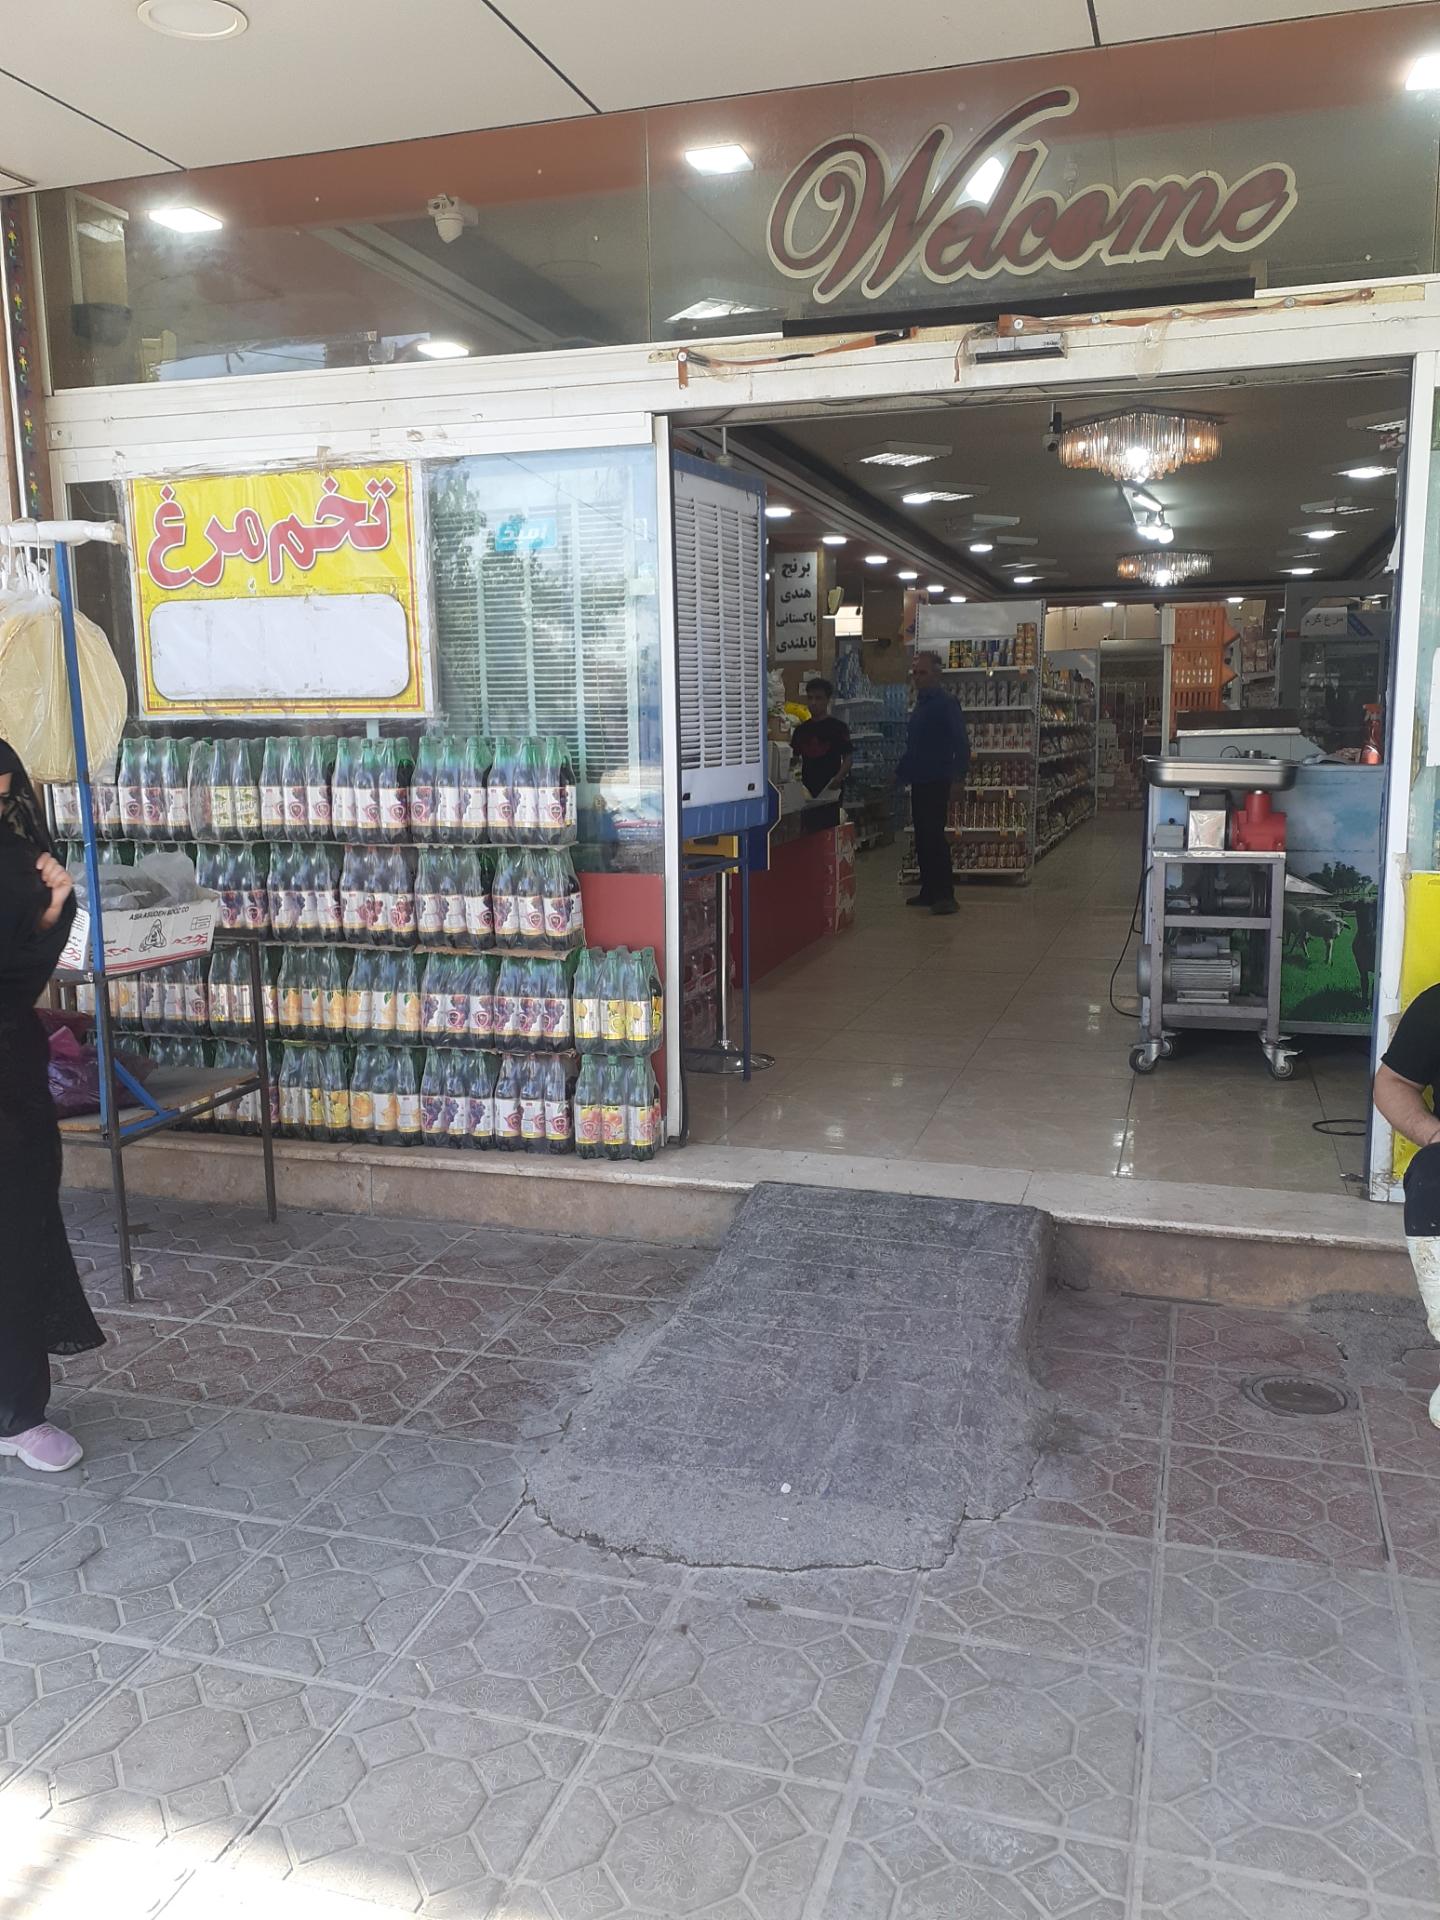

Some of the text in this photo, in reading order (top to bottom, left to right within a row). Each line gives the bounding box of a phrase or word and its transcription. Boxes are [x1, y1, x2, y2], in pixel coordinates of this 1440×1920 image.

[768, 86, 1297, 303] Welcome
[147, 476, 397, 590] تخم مرغ
[782, 558, 811, 578] برنج
[781, 588, 811, 603] هندی
[776, 636, 817, 653] تایلندی
